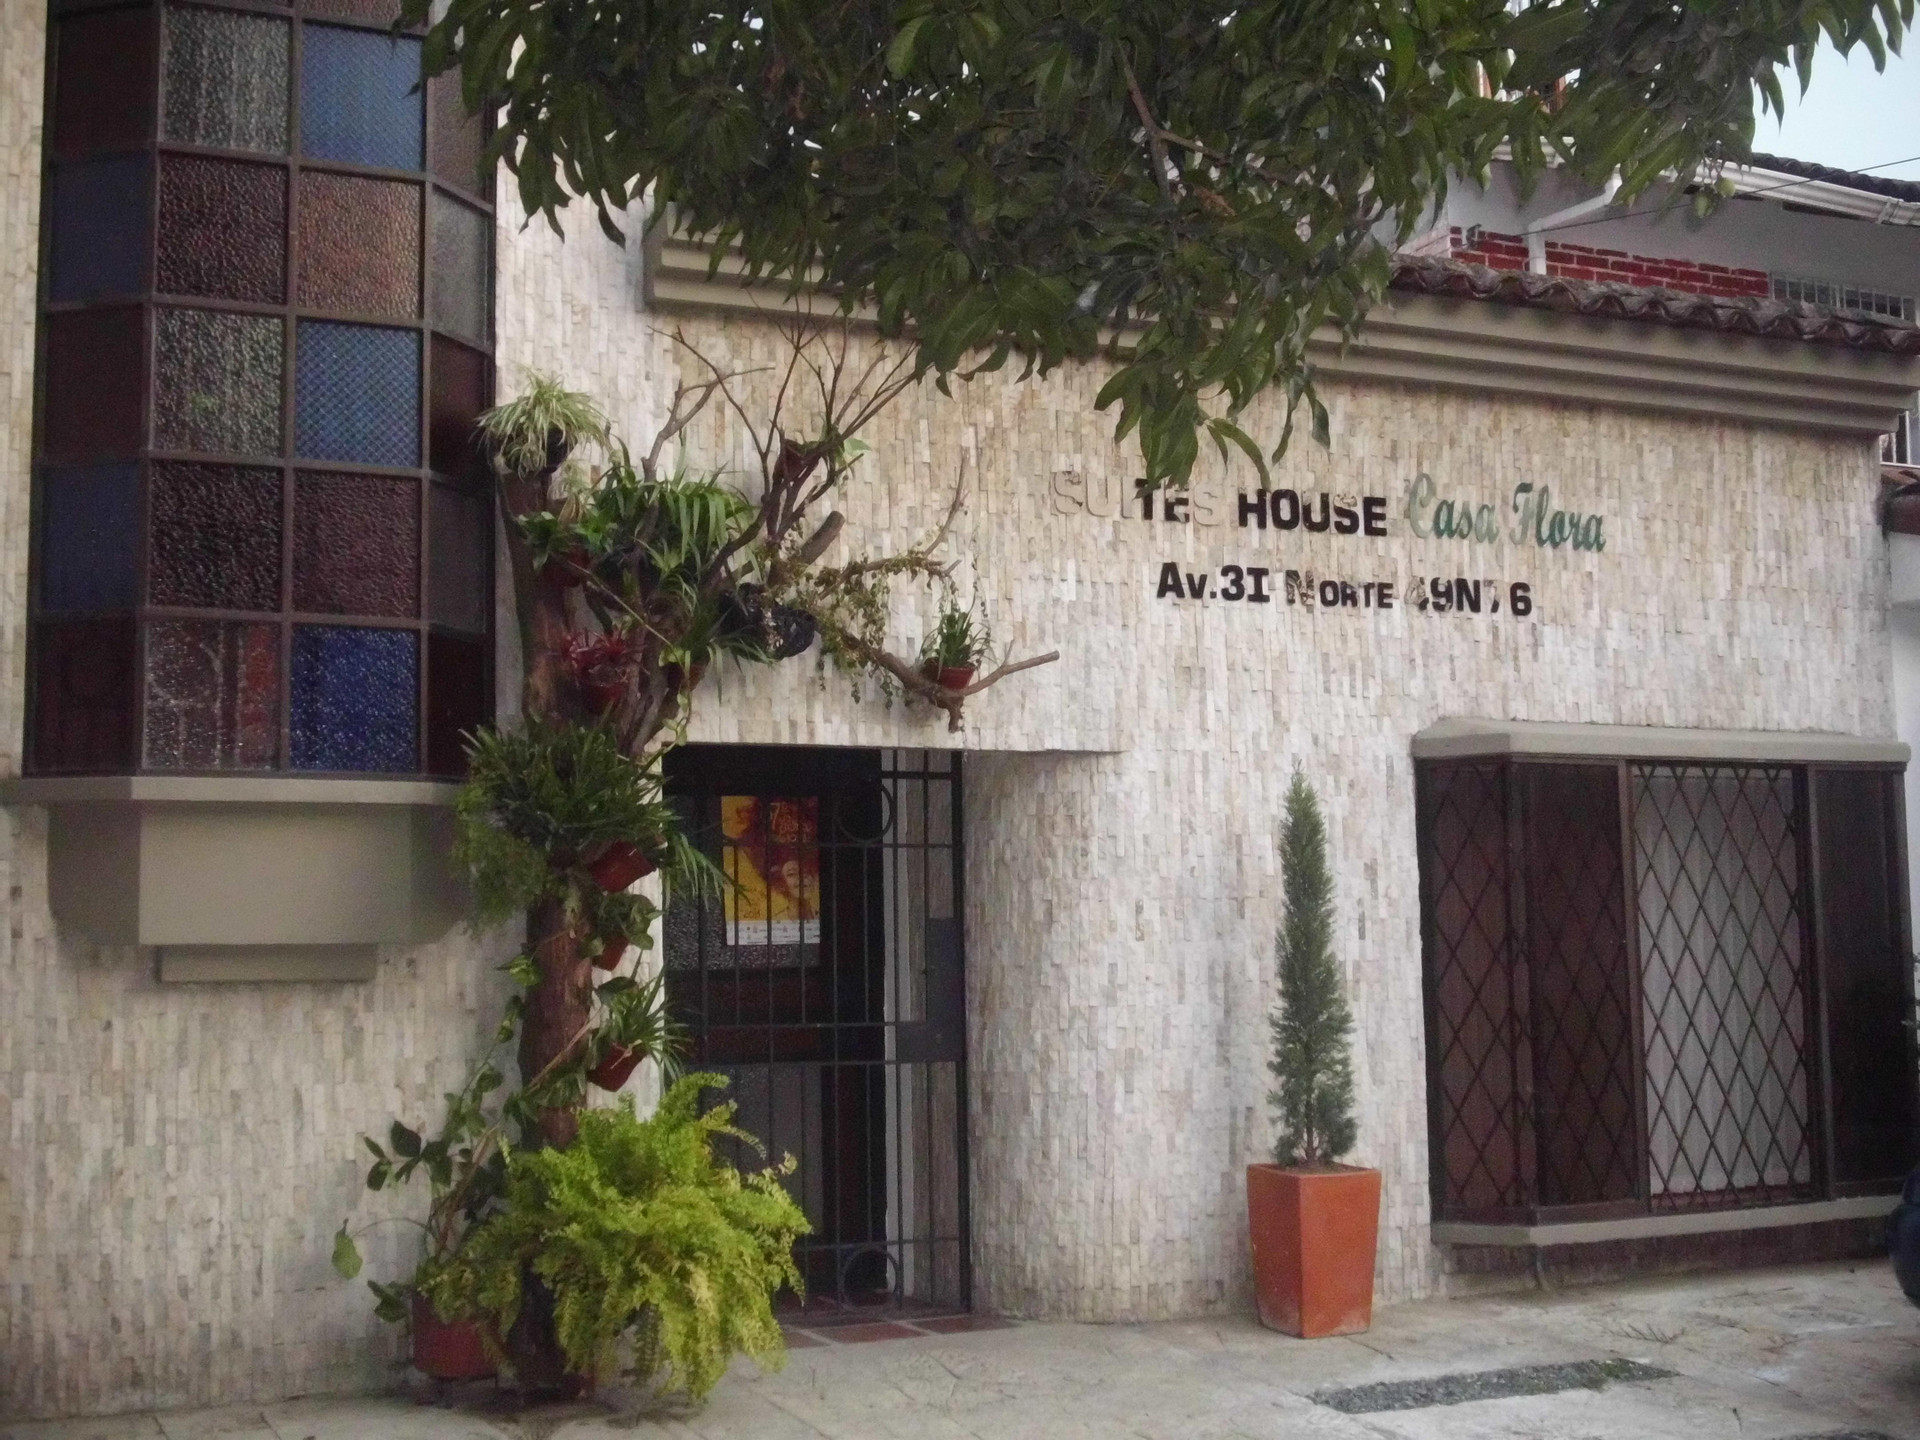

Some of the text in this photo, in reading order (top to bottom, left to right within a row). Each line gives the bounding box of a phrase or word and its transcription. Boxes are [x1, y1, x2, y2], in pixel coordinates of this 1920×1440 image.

[1238, 487, 1388, 537] HOUSE
[1408, 472, 1499, 545] Casa
[1508, 481, 1607, 552] Flora
